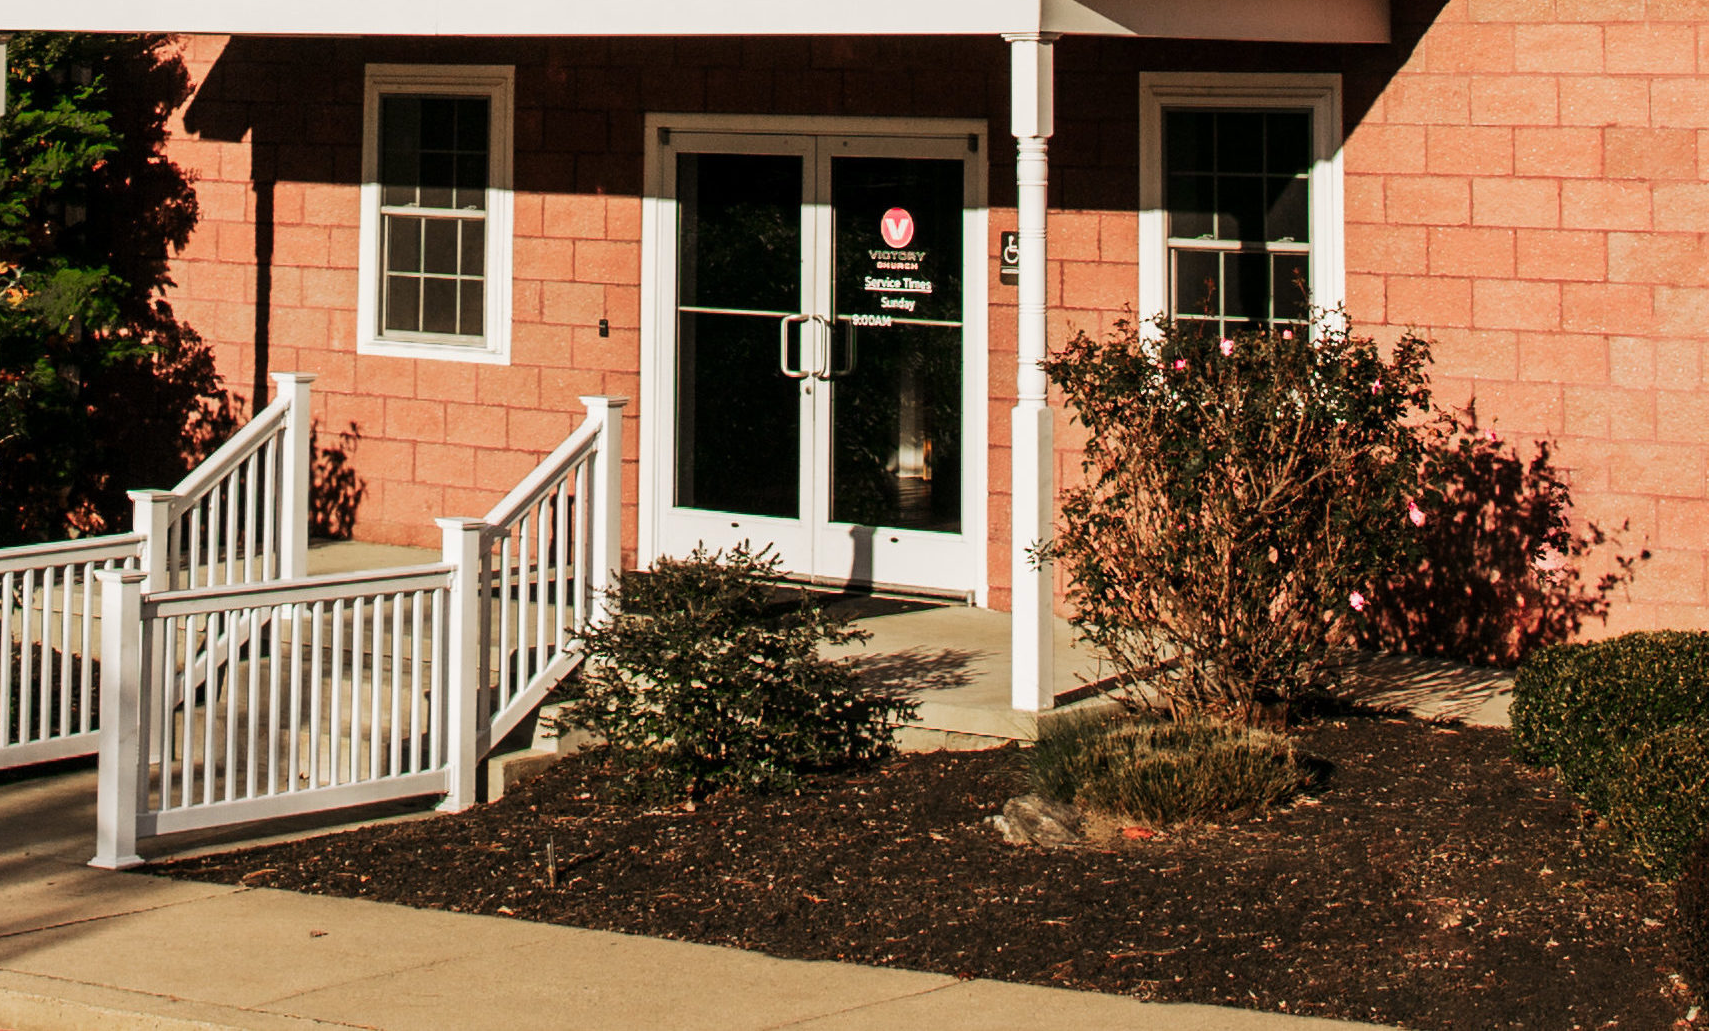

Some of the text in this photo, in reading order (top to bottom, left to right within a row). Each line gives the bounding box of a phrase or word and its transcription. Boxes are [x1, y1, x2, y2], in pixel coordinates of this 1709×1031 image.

[884, 218, 909, 240] V
[868, 249, 925, 261] VICTORY
[876, 261, 918, 269] CHURCH
[864, 275, 931, 289] Service Times
[880, 296, 915, 311] Sunday
